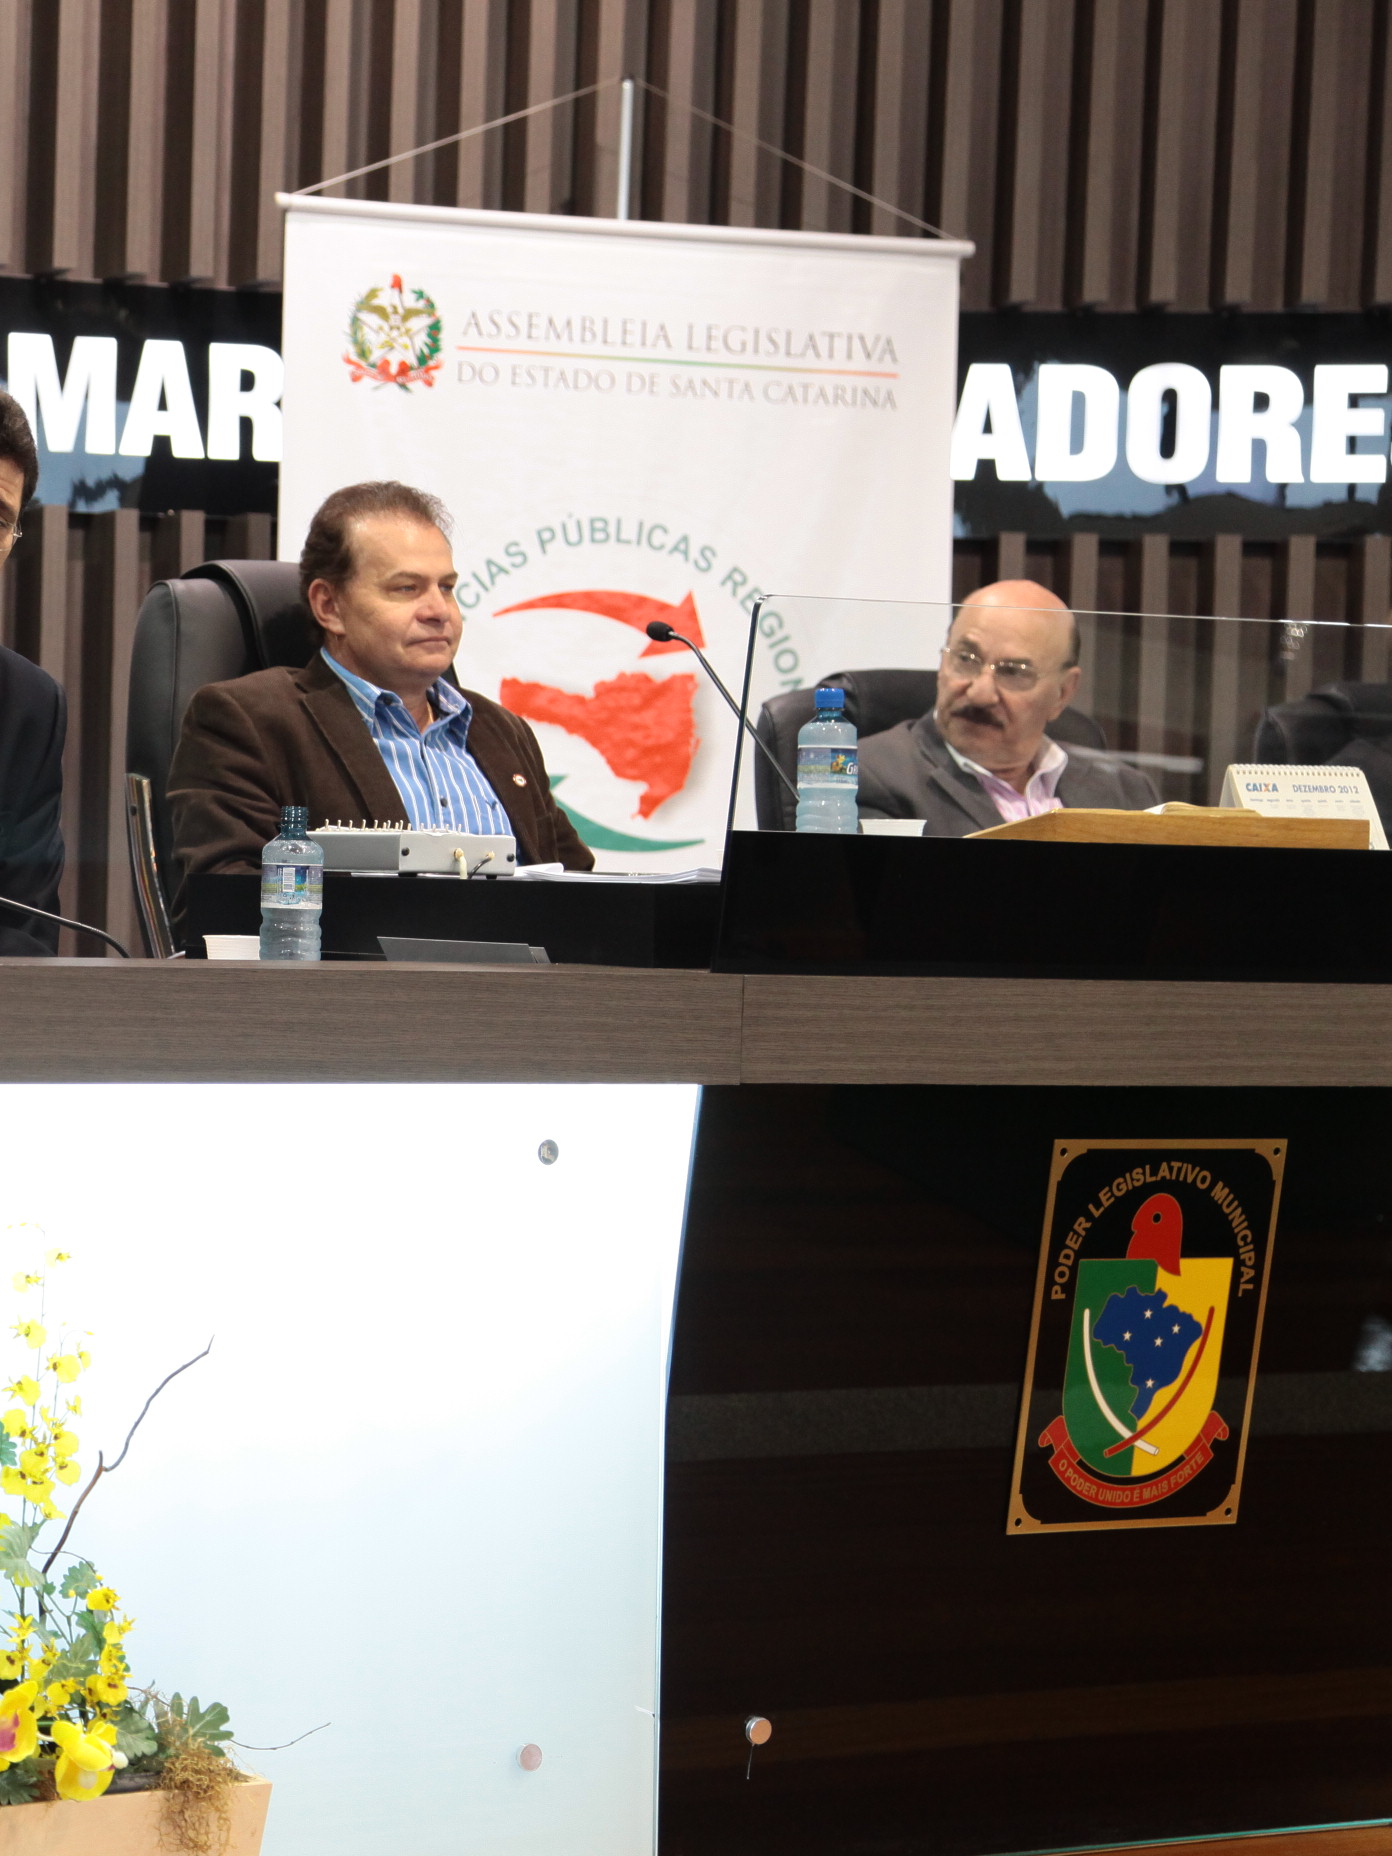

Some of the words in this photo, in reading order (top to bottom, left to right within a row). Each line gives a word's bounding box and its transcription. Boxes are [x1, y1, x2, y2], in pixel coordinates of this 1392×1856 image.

[463, 309, 673, 349] ASSEMBLEIA
[687, 322, 898, 364] LEGISLATIVA
[457, 361, 500, 386] DO
[510, 364, 616, 393] ESTADO
[626, 371, 660, 395] DE
[668, 374, 756, 401] SANTA
[762, 380, 898, 411] CATARINA
[536, 513, 717, 573] PÚBLICAS
[1245, 782, 1279, 793] CAIXA
[1292, 784, 1336, 794] DEZEMBRO
[1338, 785, 1360, 794] 2012
[1051, 1216, 1092, 1300] PODER
[1088, 1161, 1211, 1218] LEGISLATIVO
[1210, 1181, 1256, 1297] MUNICIPAL
[1065, 1468, 1097, 1498] PODER
[1098, 1488, 1131, 1503] UNIDO
[1133, 1487, 1140, 1501] É
[1170, 1452, 1204, 1488] FORTE
